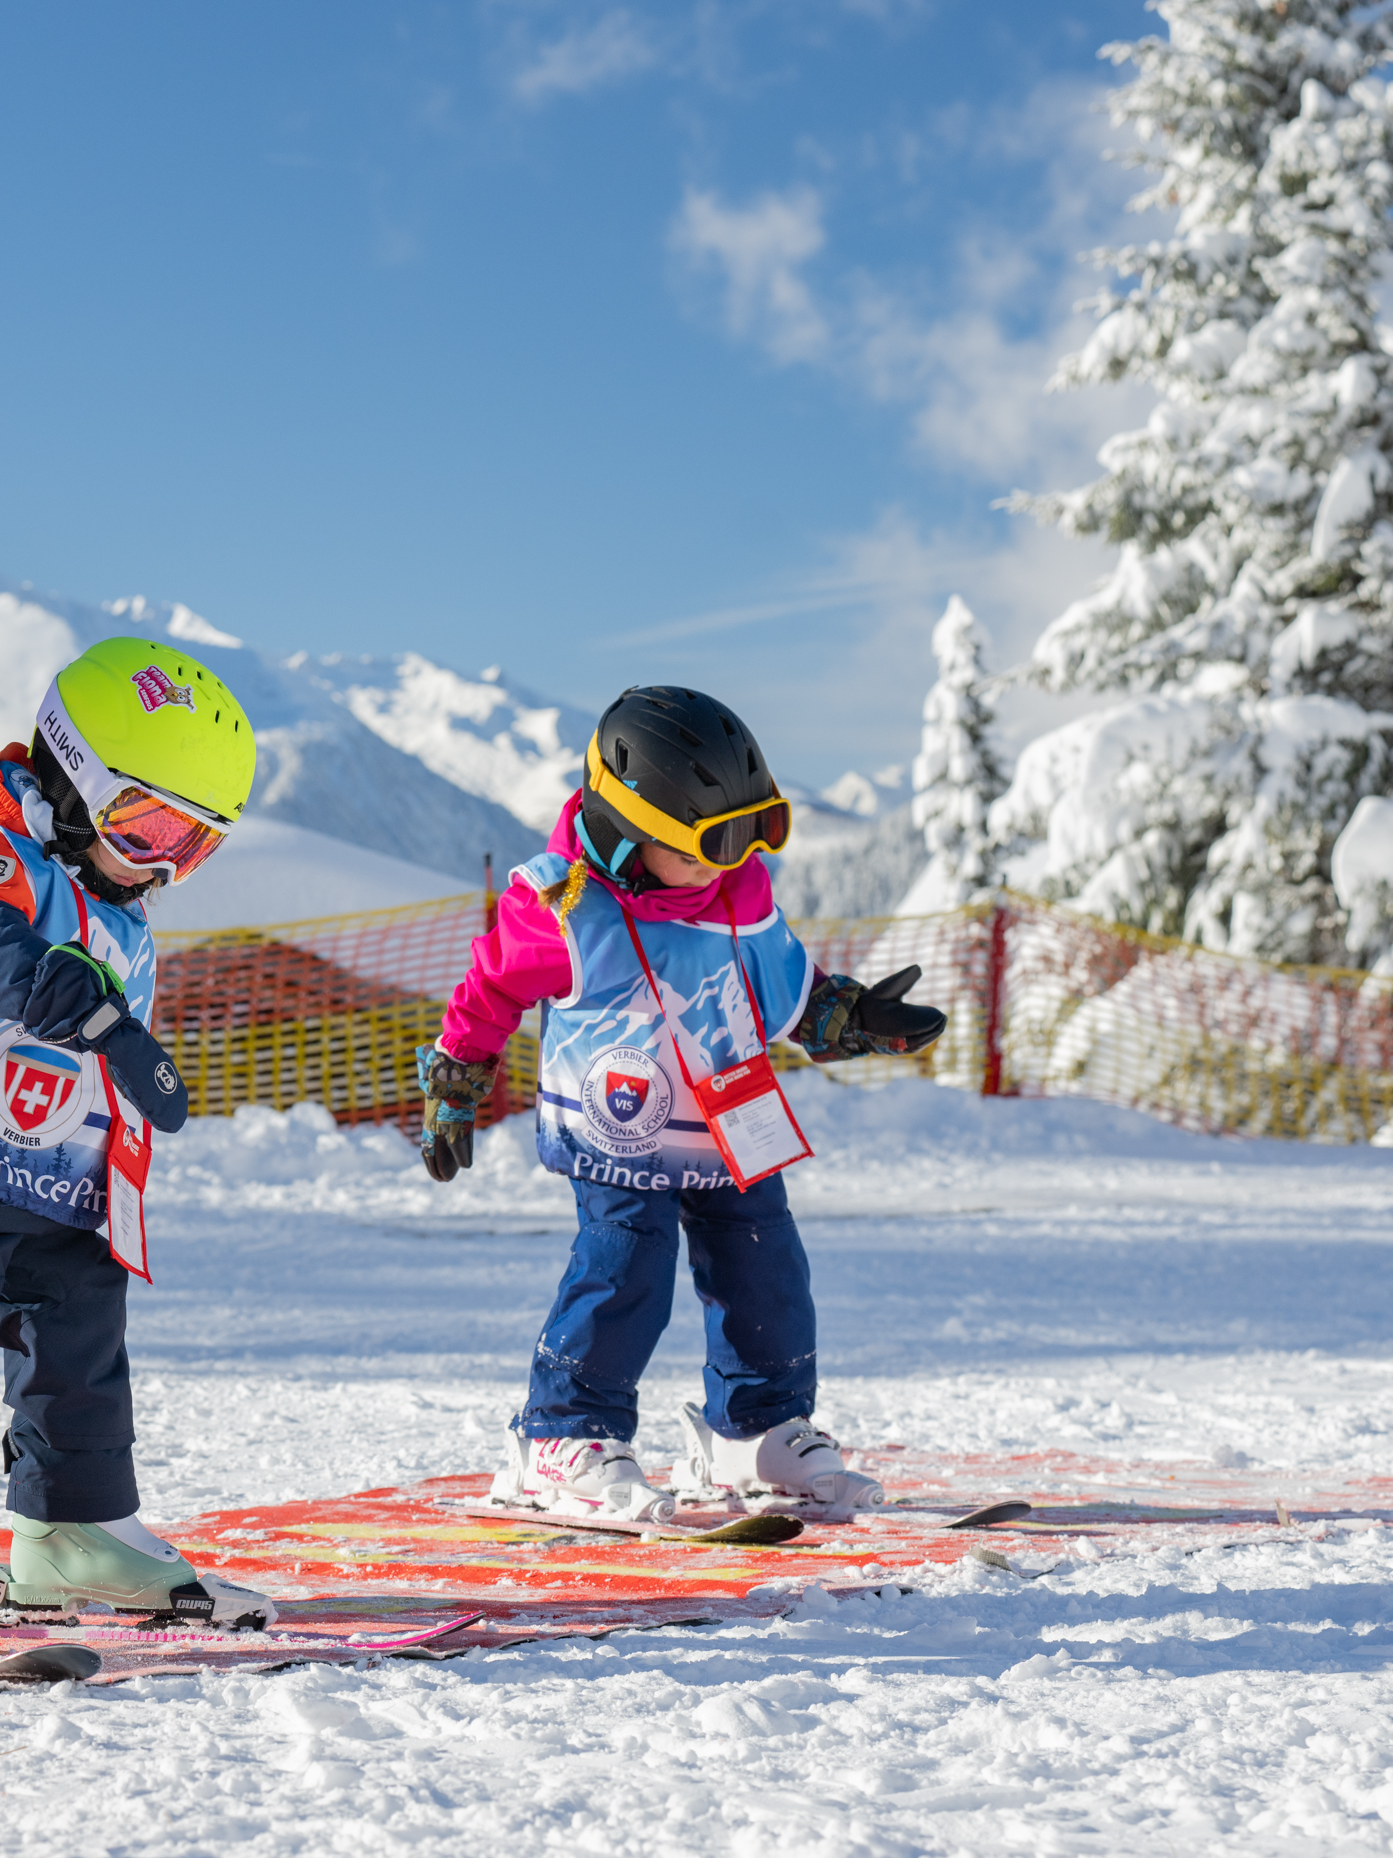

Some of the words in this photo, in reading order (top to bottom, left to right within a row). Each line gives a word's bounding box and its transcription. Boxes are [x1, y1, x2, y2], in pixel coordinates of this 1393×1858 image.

[44, 710, 84, 771] SMITH
[611, 1050, 649, 1068] VERBIER
[584, 1080, 641, 1137] INTERNATIONAL
[641, 1093, 669, 1134] SCHOOL
[615, 1098, 634, 1111] VIS
[3, 1127, 41, 1147] VERBIER
[586, 1129, 657, 1154] SWITZERLAND
[573, 1152, 670, 1191] Prince
